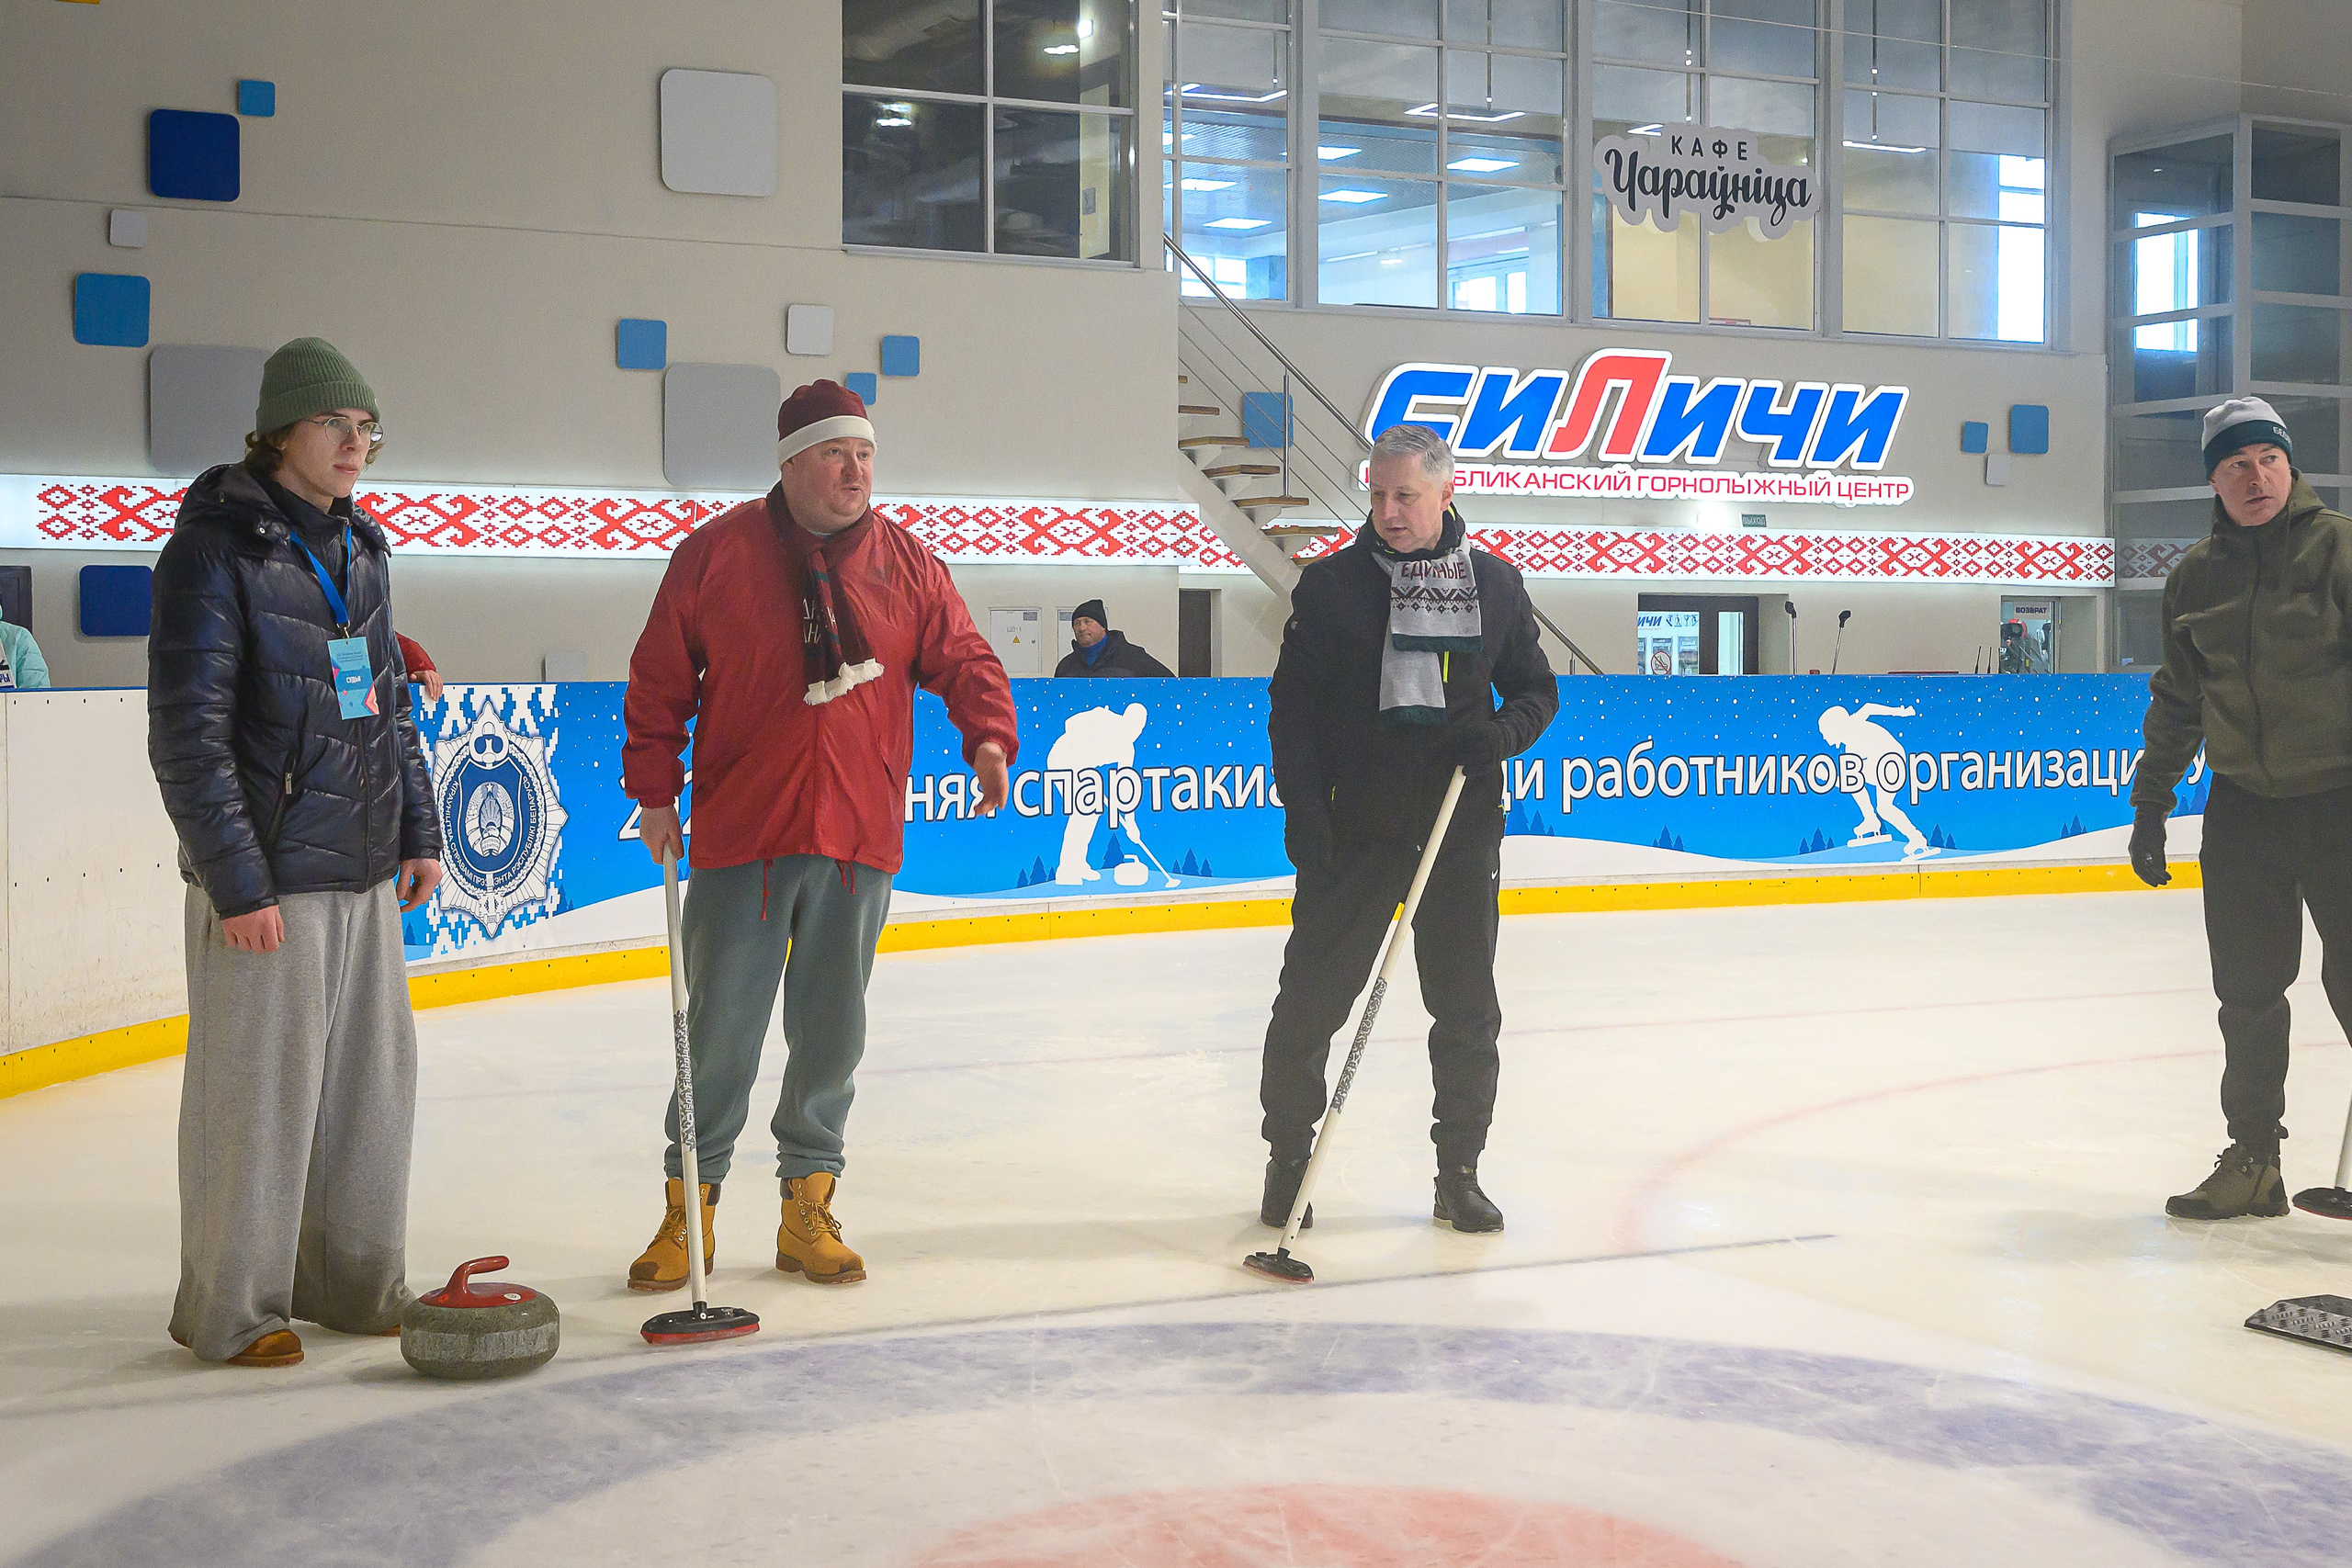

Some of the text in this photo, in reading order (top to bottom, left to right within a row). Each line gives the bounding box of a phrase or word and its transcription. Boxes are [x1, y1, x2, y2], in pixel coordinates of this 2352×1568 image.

[1671, 135, 1747, 161] КАФЕ
[1604, 148, 1813, 226] Чараўніца
[1364, 465, 1910, 501] БЛИКАНСКИЙ ГОРНОЛЫЖНЫЙ ЦЕНТР
[1400, 561, 1468, 581] ЕДИНЫЕ
[1637, 615, 1663, 626] ИЧИ
[1012, 765, 1284, 829] спартаки
[1561, 739, 1866, 815] работников
[1876, 748, 2146, 807] организаци
[472, 871, 514, 887] ПРЭЭНТА
